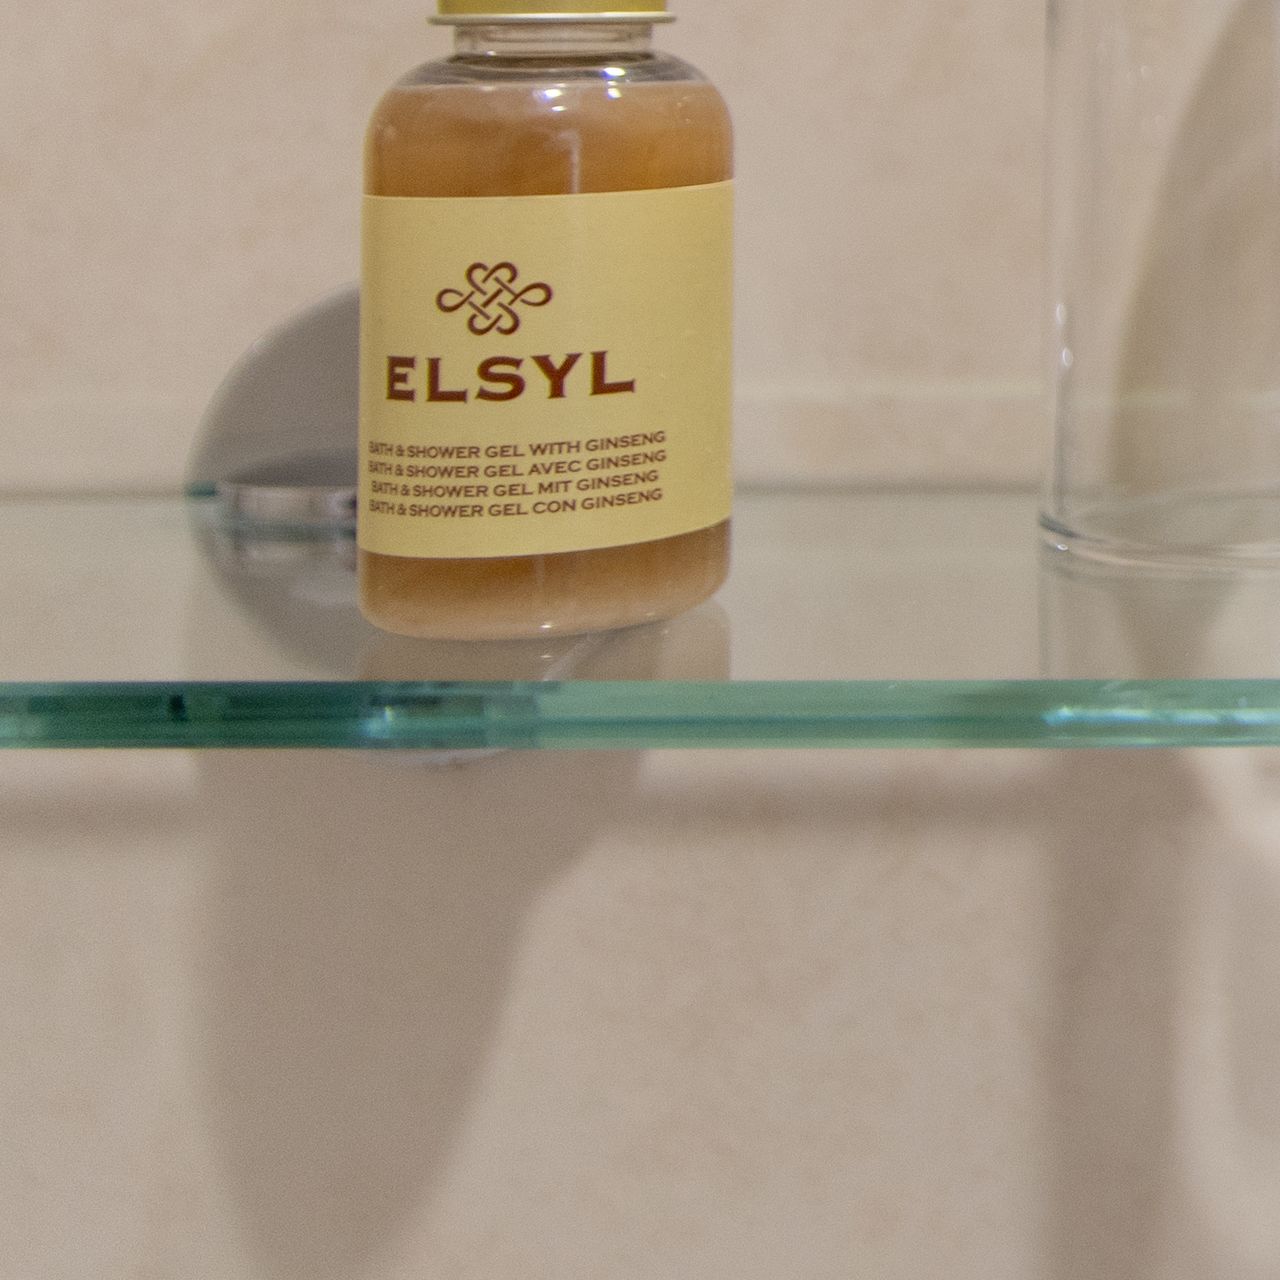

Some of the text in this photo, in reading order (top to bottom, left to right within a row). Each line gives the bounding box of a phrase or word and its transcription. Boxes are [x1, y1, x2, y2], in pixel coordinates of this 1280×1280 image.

[386, 350, 636, 402] ELSYL
[369, 430, 666, 458] BATH & SHOWER GEL WITH GINSENG
[368, 450, 667, 478] BATH & SHOWER GEL AVEC GINSENG
[372, 470, 659, 498] BATH & SHOWER GEL MIT GINSENG
[369, 488, 662, 518] BATH & SHOWER GEL CON GINSENG
